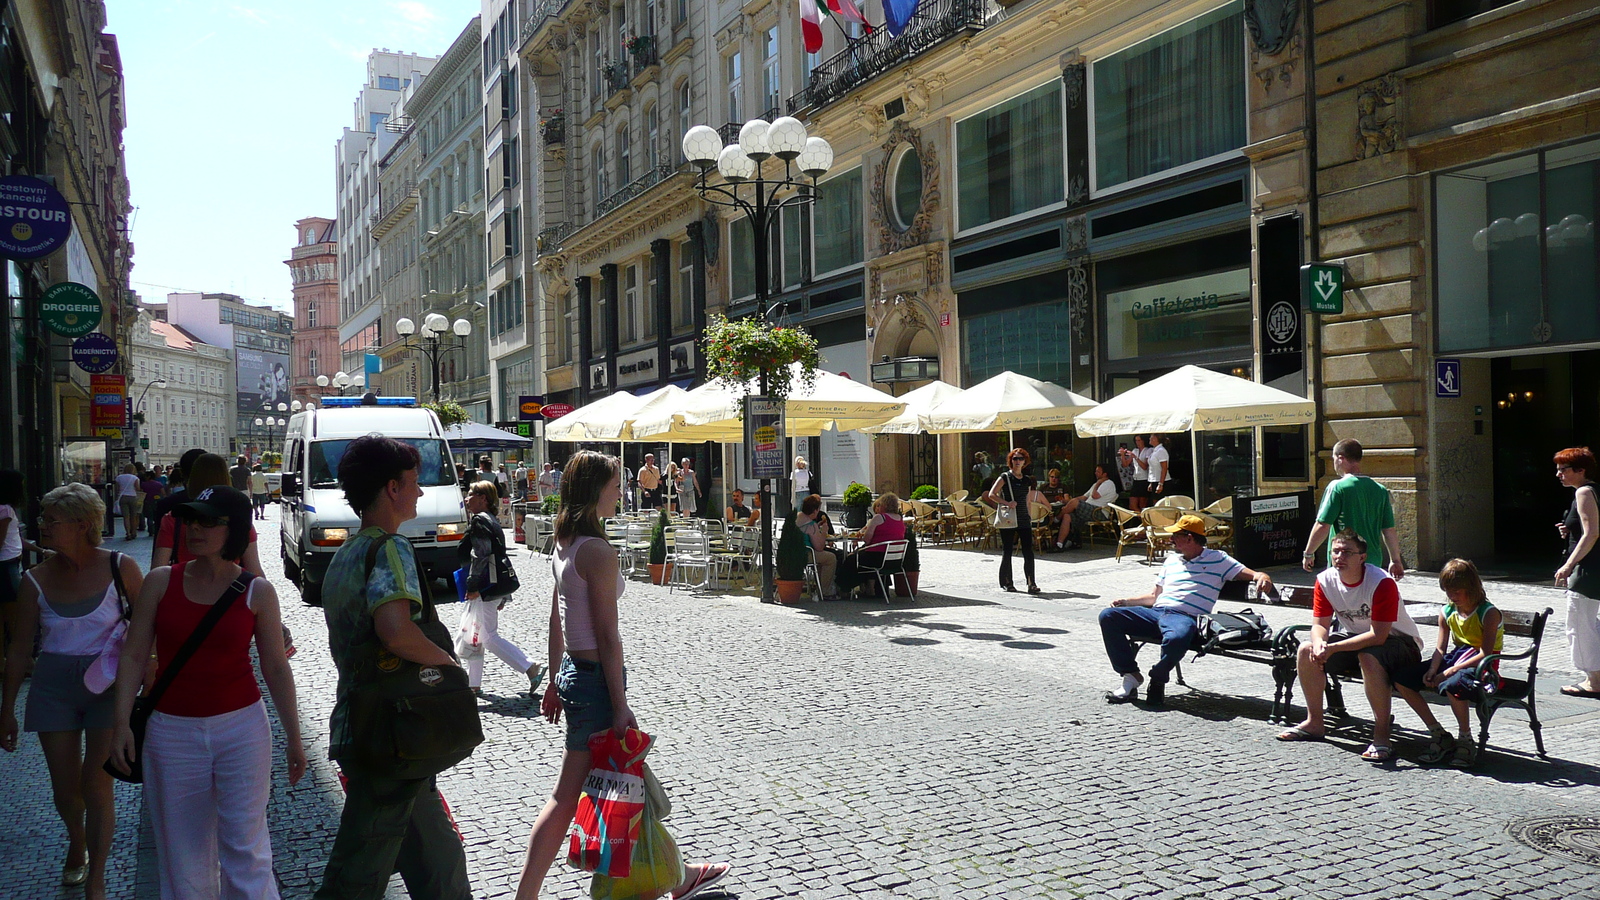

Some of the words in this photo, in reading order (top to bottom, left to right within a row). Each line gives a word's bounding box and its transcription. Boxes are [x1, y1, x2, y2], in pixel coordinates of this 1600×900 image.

[17, 237, 55, 253] kosmetika
[48, 285, 72, 299] BARVY
[74, 286, 94, 300] LAKY
[42, 303, 100, 312] DROGERIE
[1131, 291, 1219, 320] Caffeteria
[49, 318, 94, 333] PARFUMERIE
[95, 395, 120, 404] digital
